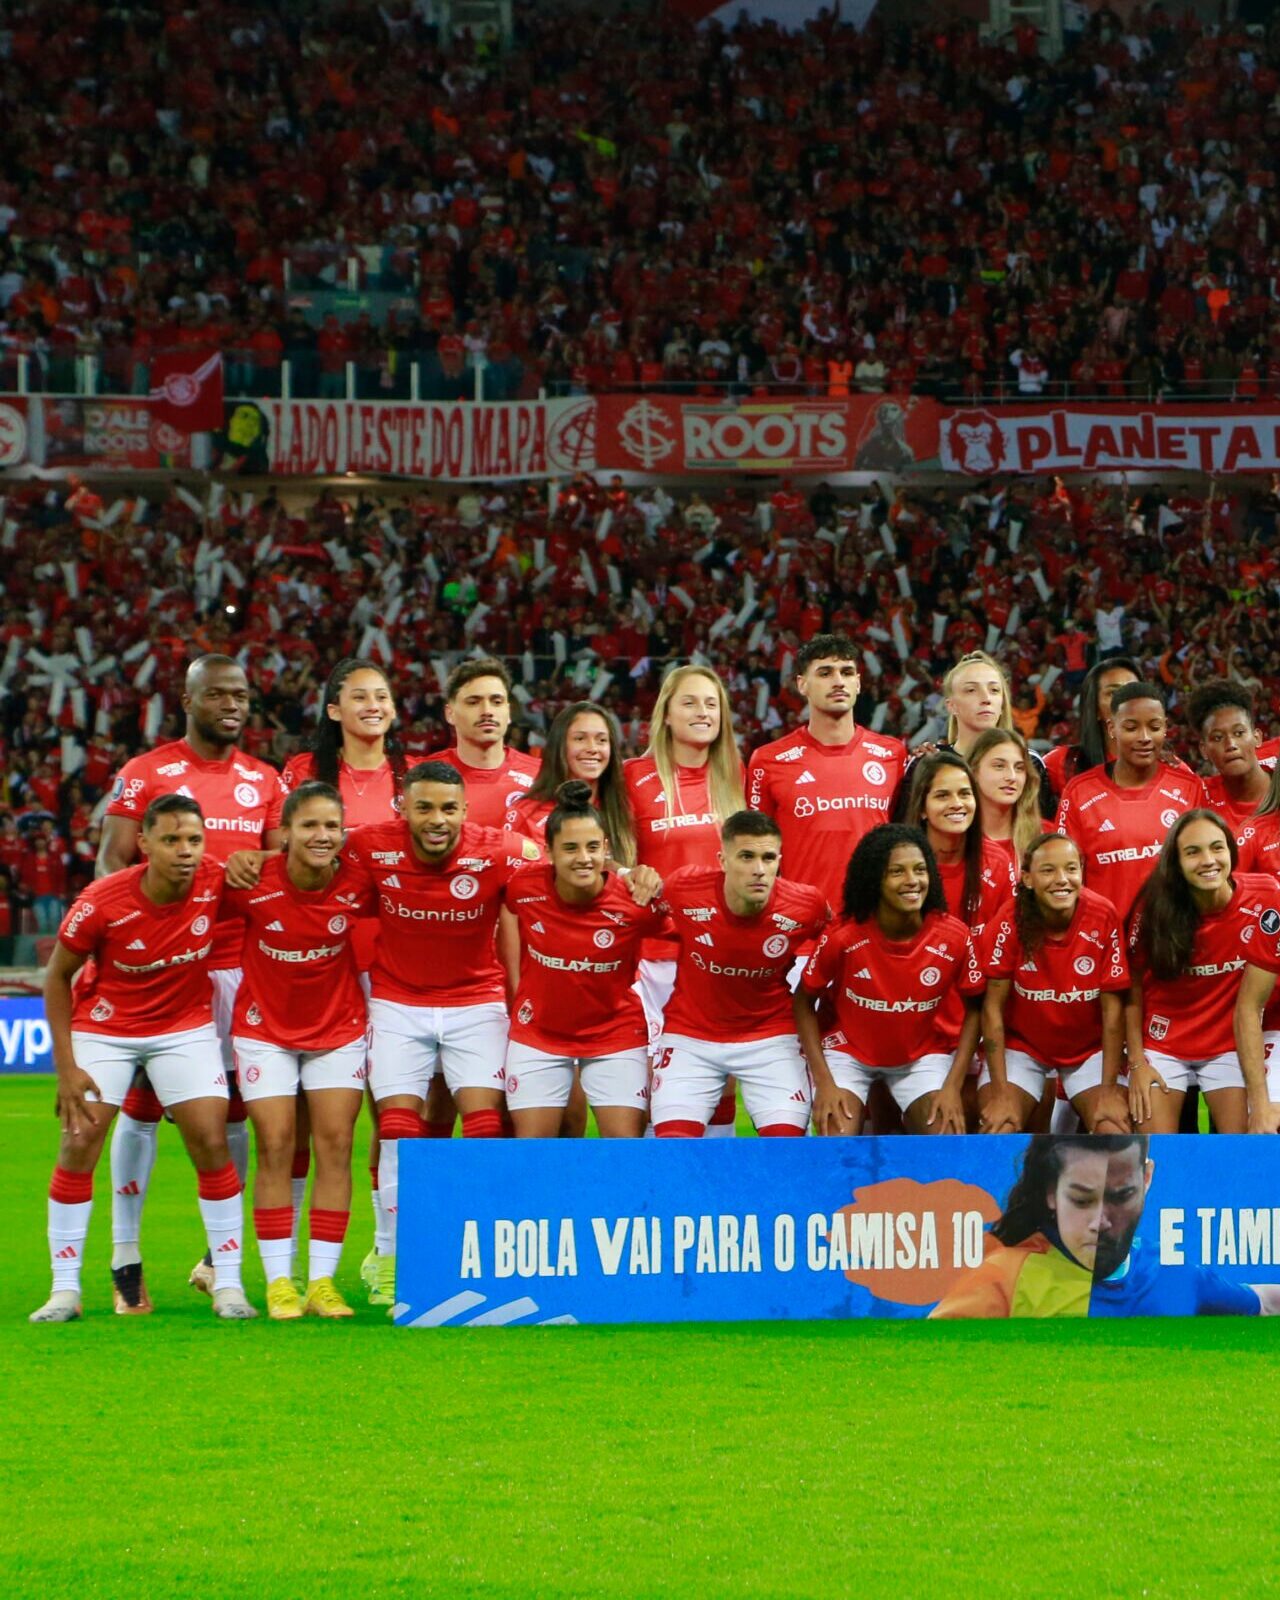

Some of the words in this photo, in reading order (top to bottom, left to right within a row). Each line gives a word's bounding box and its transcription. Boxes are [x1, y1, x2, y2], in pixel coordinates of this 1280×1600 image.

[272, 403, 339, 474] LADO
[345, 404, 426, 476] LESTE
[430, 402, 465, 477] DO
[471, 404, 547, 475] MAPA
[683, 412, 848, 459] ROOTS
[1017, 409, 1261, 472] PLANETA
[816, 794, 890, 812] banrisul
[204, 816, 264, 834] anrisul
[651, 813, 711, 833] ESTRELA
[1057, 811, 1067, 836] ero
[1096, 846, 1152, 865] ESTRELA
[65, 912, 83, 938] vero
[398, 903, 484, 921] banrisul
[965, 936, 978, 969] vero
[989, 932, 1007, 966] vero
[1111, 928, 1120, 963] vero
[594, 959, 622, 973] BET
[710, 961, 777, 978] banris
[845, 987, 903, 1013] ESTRELA
[918, 995, 943, 1013] BET
[1014, 982, 1068, 1004] ESTRELA
[1084, 989, 1100, 1002] BE
[460, 1219, 482, 1279] A
[494, 1217, 578, 1278] BOLA
[591, 1216, 661, 1276] VAI
[673, 1213, 761, 1275] PARA
[773, 1213, 795, 1272] O
[806, 1210, 939, 1271] CAMISA
[951, 1210, 984, 1269] 10
[1159, 1208, 1185, 1266] E
